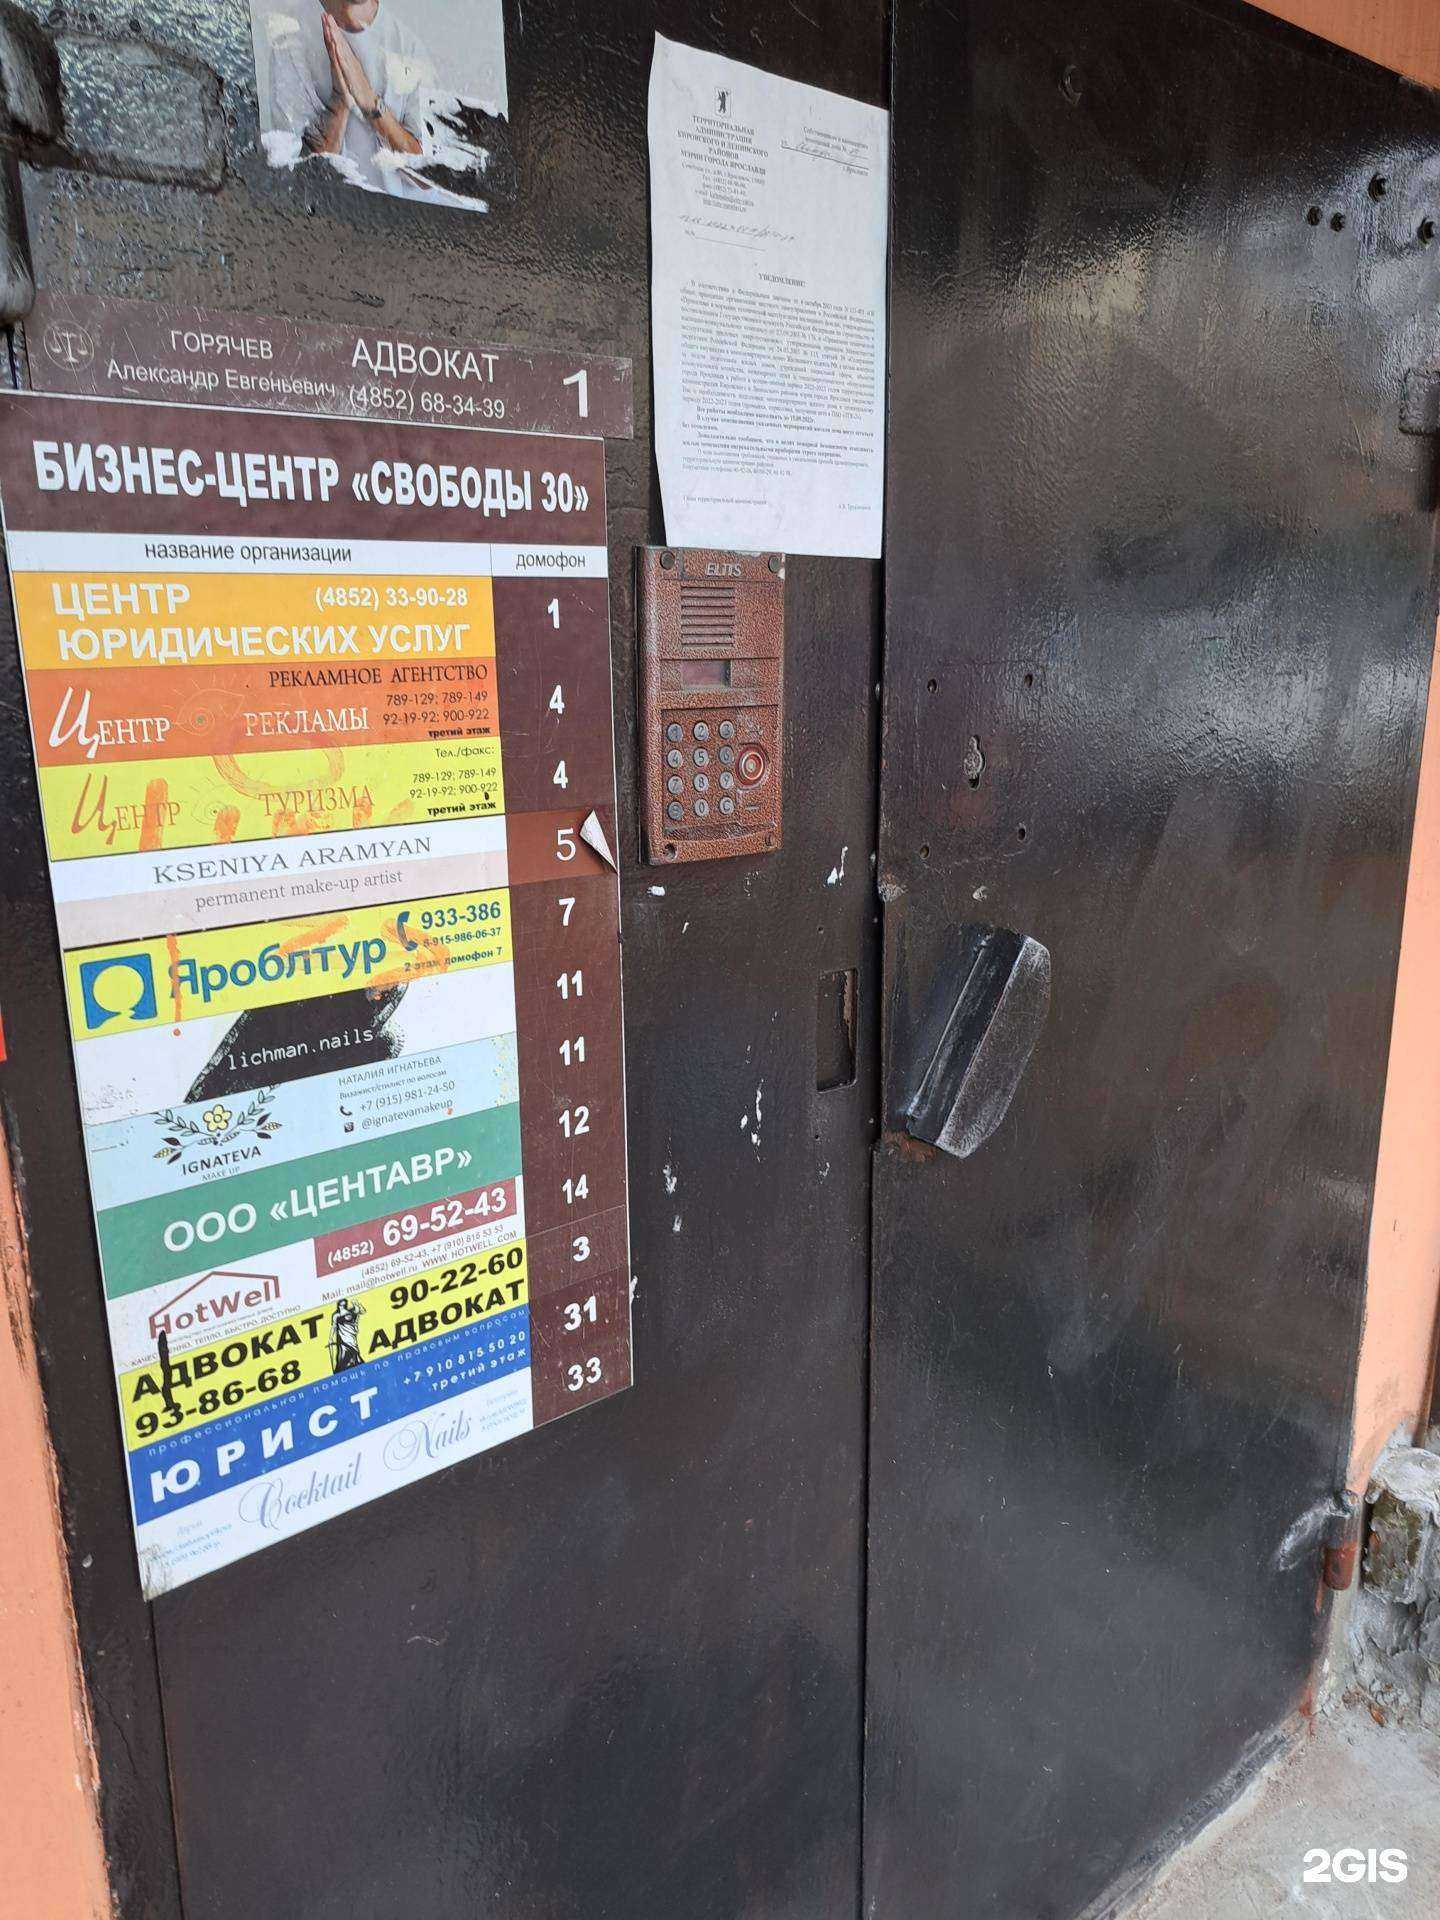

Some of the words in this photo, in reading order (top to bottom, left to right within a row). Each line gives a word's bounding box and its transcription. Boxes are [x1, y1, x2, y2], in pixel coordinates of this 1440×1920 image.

[170, 330, 273, 360] ГОРЯЧЕВ
[107, 359, 220, 390] Александр
[225, 371, 336, 400] Евгеньевич
[351, 338, 500, 383] АДВОКАТ
[562, 369, 590, 418] 1
[350, 384, 415, 414] (4852)
[420, 392, 506, 420] 68-34-39
[33, 440, 340, 507] БИЗНЕС-ЦЕНТР
[352, 461, 532, 518] «СВОБОДЫ
[541, 471, 590, 514] 30»
[145, 543, 236, 562] название
[241, 545, 352, 565] организации
[516, 552, 587, 570] домофон
[53, 583, 191, 622] ЦЕНТР
[315, 588, 380, 613] (4852)
[386, 587, 469, 609] 33-90-28
[546, 598, 561, 630] 1
[59, 624, 357, 665] ЮРИДИЧЕСКИХ
[367, 624, 471, 656] УСЛУГ
[269, 668, 381, 688] РЕКЛАМНОЕ
[391, 664, 489, 684] АГЕНТСТВО
[442, 690, 488, 704] 789-149
[549, 684, 565, 714] 4
[243, 707, 369, 737] РЕКЛАМЫ
[443, 708, 490, 722] 900-922
[428, 727, 464, 740] третий
[466, 725, 492, 737] этаж
[435, 745, 496, 759] Тел./факс:
[697, 751, 706, 764] 5
[458, 767, 497, 781] 789-149
[459, 782, 498, 796] 900-922
[552, 760, 568, 788] 4
[697, 776, 706, 789] 8
[258, 783, 374, 818] ТУРИЗМА
[427, 803, 467, 817] третий
[469, 801, 498, 813] этаж
[152, 853, 291, 885] KSENIYA
[299, 836, 433, 868] ARAMYAN
[556, 828, 577, 862] 5
[195, 888, 287, 912] permanent
[291, 873, 359, 897] make-up
[364, 869, 404, 887] artist
[421, 901, 502, 930] 933-386
[558, 897, 576, 927] 7
[169, 936, 388, 1004] Яроблтур
[404, 962, 412, 973] 2
[444, 948, 494, 967] домофон
[496, 946, 503, 956] 7
[556, 969, 584, 1000] 11
[228, 1027, 374, 1071] lichman.nails
[559, 1036, 586, 1067] 11
[338, 1068, 385, 1087] НАТАЛИЯ
[387, 1056, 442, 1076] ИГНАТЬЕВА
[360, 1100, 373, 1112] +7
[375, 1093, 402, 1110] (915)
[404, 1080, 455, 1101] 981-24-50
[361, 1099, 453, 1130] @ignatevamakeup
[559, 1105, 590, 1138] 12
[182, 1146, 262, 1176] IGNATEVA
[202, 1169, 227, 1181] MAKE
[228, 1166, 240, 1177] UP
[163, 1202, 257, 1252] ООО
[269, 1147, 474, 1222] «ЦЕНТАВР»
[562, 1174, 589, 1205] 14
[327, 1240, 375, 1269] (4852)
[382, 1187, 507, 1247] 69-52-43
[572, 1236, 590, 1262] 3
[321, 1286, 344, 1302] Mail:
[346, 1265, 418, 1294] mail@hotwell.ru
[390, 1247, 524, 1311] 90-22-60
[148, 1279, 282, 1339] HotWell
[368, 1278, 526, 1355] АДВОКАТ
[563, 1296, 597, 1332] 31
[131, 1313, 324, 1403] АДВОКАТ
[374, 1360, 390, 1372] по
[403, 1370, 421, 1387] +7
[426, 1357, 453, 1377] 910
[456, 1346, 483, 1365] 815
[488, 1337, 506, 1354] 50
[509, 1330, 526, 1346] 20
[431, 1362, 486, 1393] третий
[490, 1348, 527, 1369] этаж
[567, 1355, 603, 1393] 33
[135, 1359, 302, 1439] 93-86-68
[150, 1386, 379, 1504] ЮРИСТ
[238, 1451, 362, 1531] Cocktail
[383, 1409, 472, 1472] Nails
